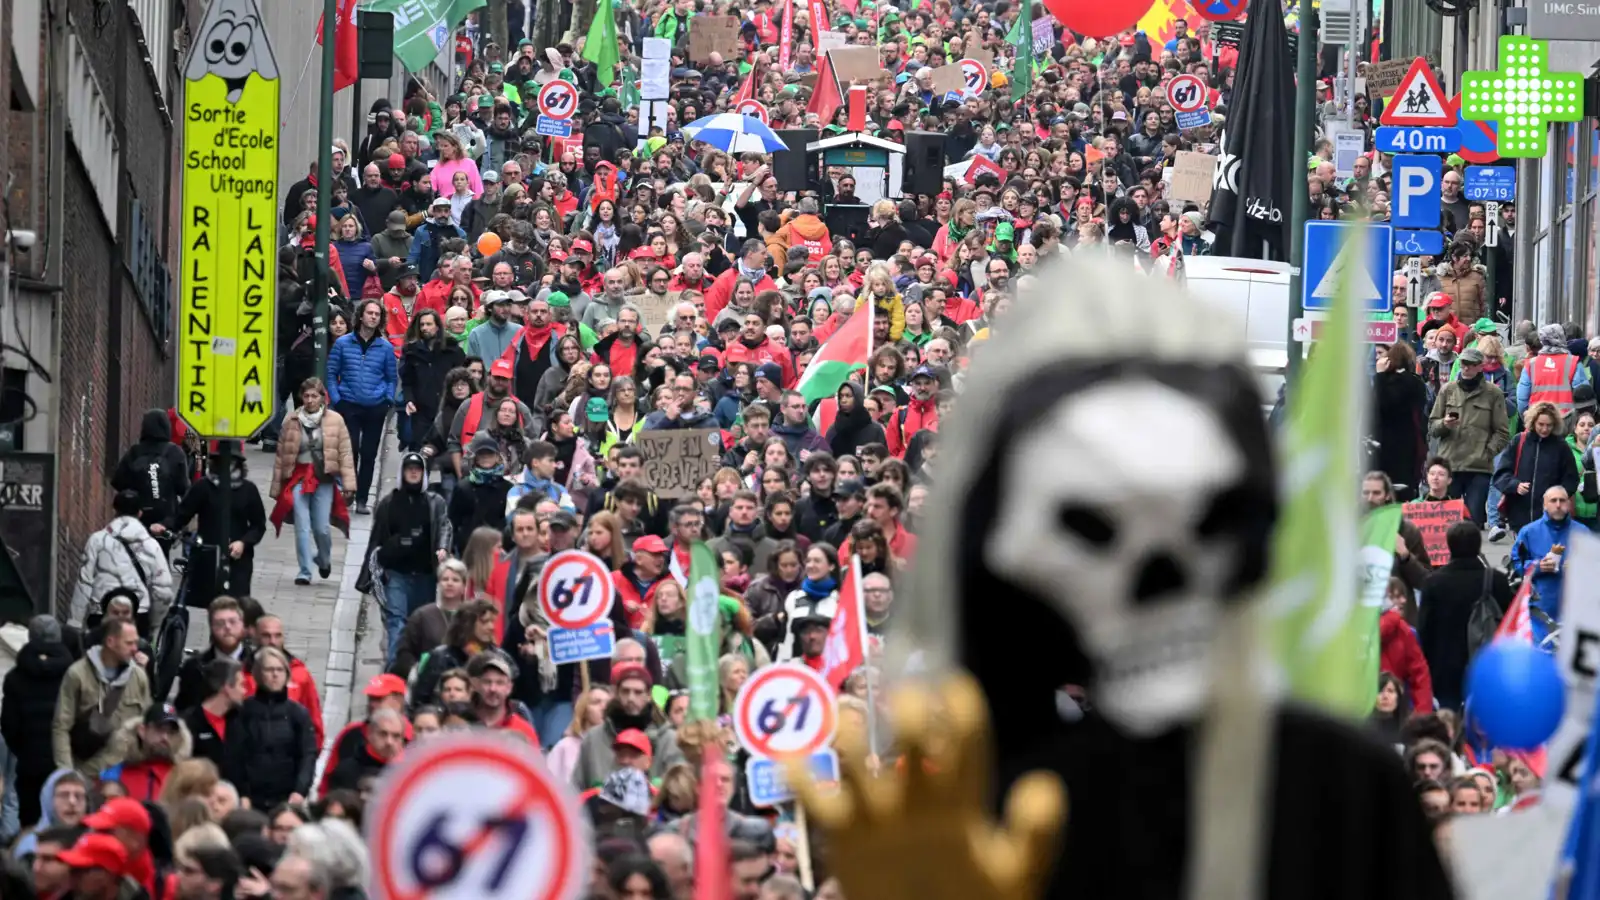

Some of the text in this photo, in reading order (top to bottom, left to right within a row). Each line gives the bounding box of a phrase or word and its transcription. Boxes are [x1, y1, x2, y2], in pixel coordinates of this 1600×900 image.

[1544, 3, 1574, 15] UMC
[545, 92, 571, 109] 67
[1175, 85, 1197, 104] 67
[188, 103, 246, 124] Sortie
[213, 127, 274, 149] d'Ecole
[186, 149, 246, 170] School
[210, 173, 274, 200] Uitgang
[1398, 166, 1434, 217] P
[1495, 188, 1507, 198] 19
[188, 205, 211, 413] RALENTIR
[240, 207, 265, 414] LANGZAAM
[680, 436, 702, 457] EN
[551, 576, 594, 609] 67
[757, 697, 812, 734] 67
[410, 808, 528, 893] 67
